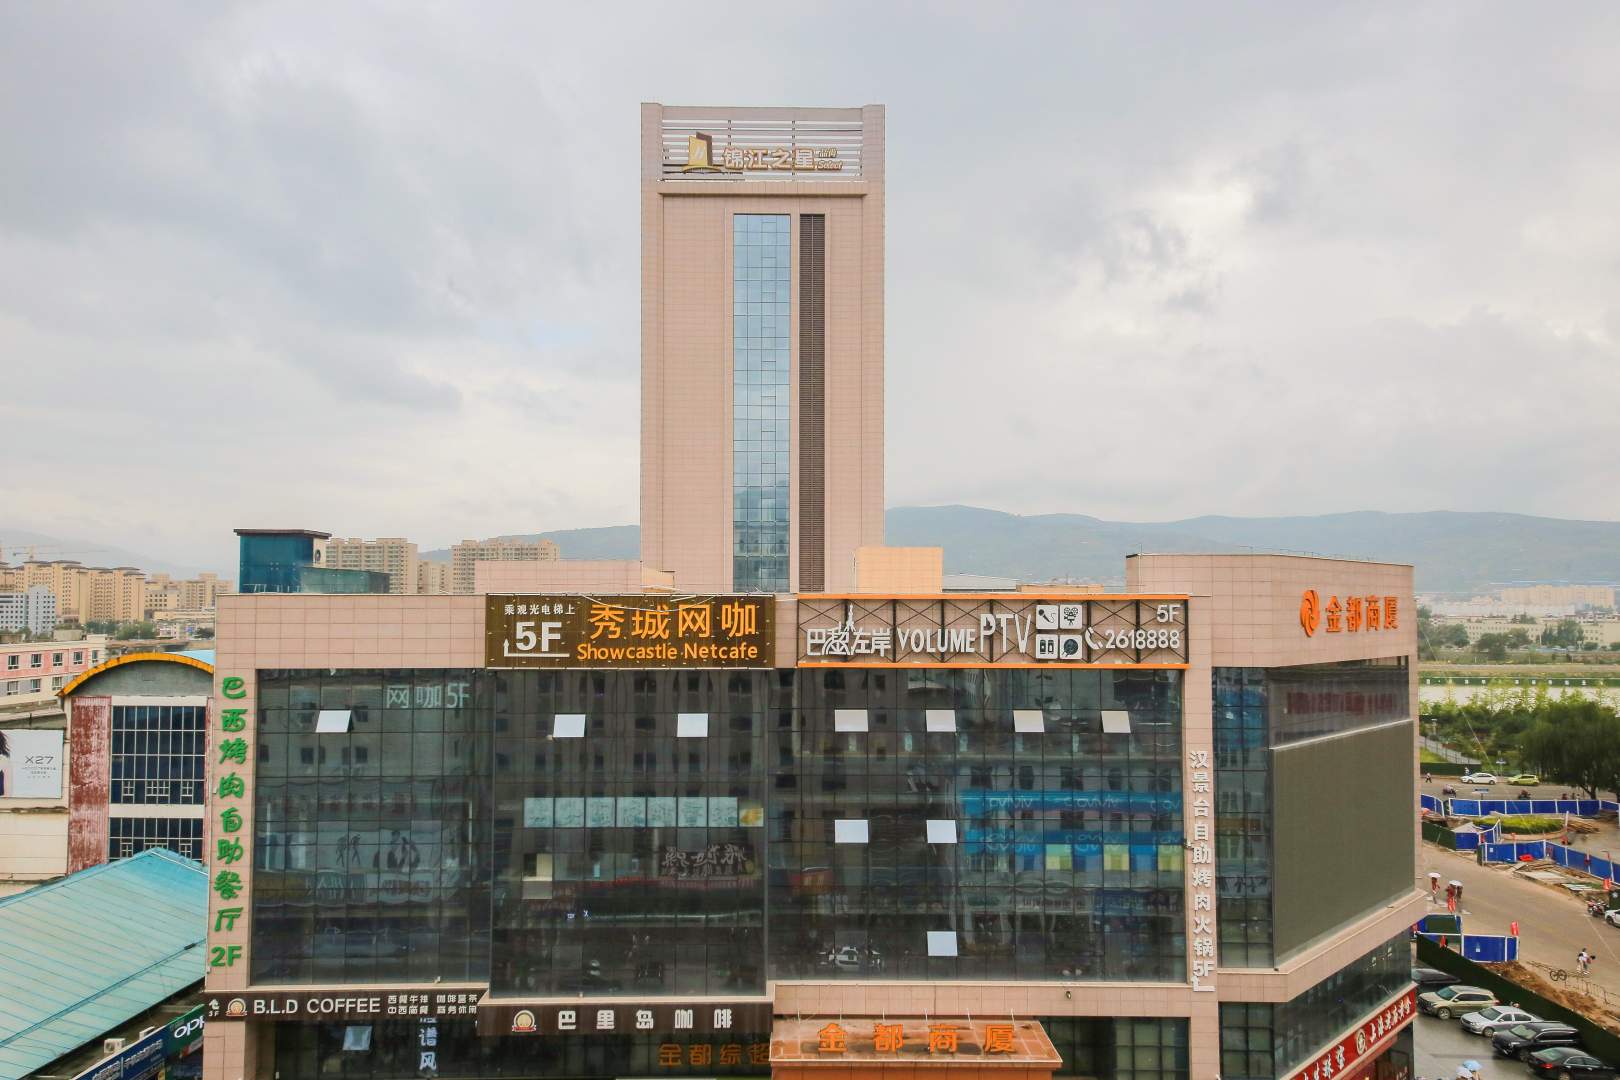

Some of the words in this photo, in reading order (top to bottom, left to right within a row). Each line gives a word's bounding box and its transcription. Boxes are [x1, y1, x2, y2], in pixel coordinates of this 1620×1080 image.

[723, 147, 815, 170] 锦江之星
[817, 160, 843, 171] Select
[504, 603, 576, 616] 乘观光电梯上
[1156, 604, 1181, 623] 5F
[1325, 595, 1398, 633] 金都商厦
[589, 602, 756, 640] 秀城网咖
[515, 621, 562, 652] 5F
[896, 627, 976, 654] VOLUME
[980, 613, 1032, 653] PTV
[1104, 629, 1181, 650] 2618888
[577, 643, 678, 660] Showcastle
[684, 642, 758, 660] Netcafe
[253, 999, 298, 1014] B.L.D
[306, 998, 381, 1014] COFFEE
[558, 1008, 733, 1030] 巴里岛咖啡
[817, 1023, 1016, 1053] 金都商厦
